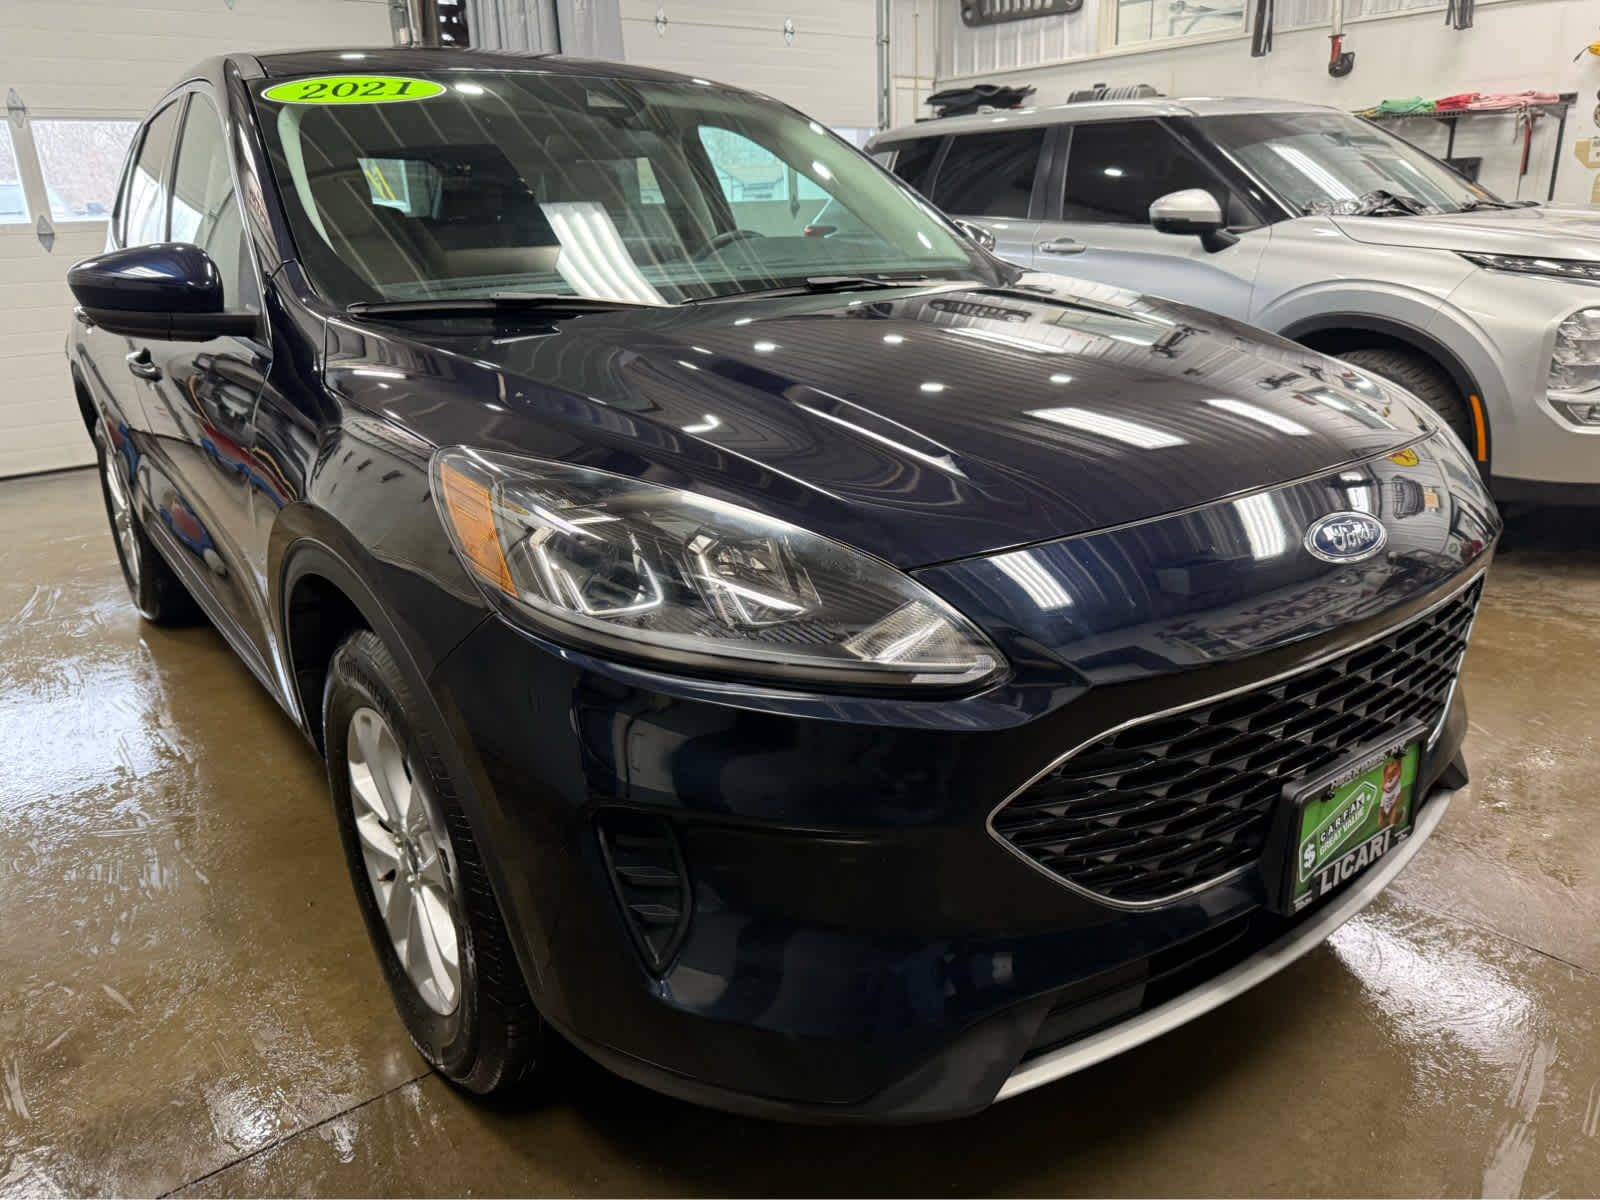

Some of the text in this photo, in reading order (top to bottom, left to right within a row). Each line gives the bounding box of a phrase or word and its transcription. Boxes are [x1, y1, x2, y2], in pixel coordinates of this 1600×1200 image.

[298, 81, 413, 100] 2021
[1322, 519, 1378, 552] Ford
[1319, 829, 1391, 896] LICARI
